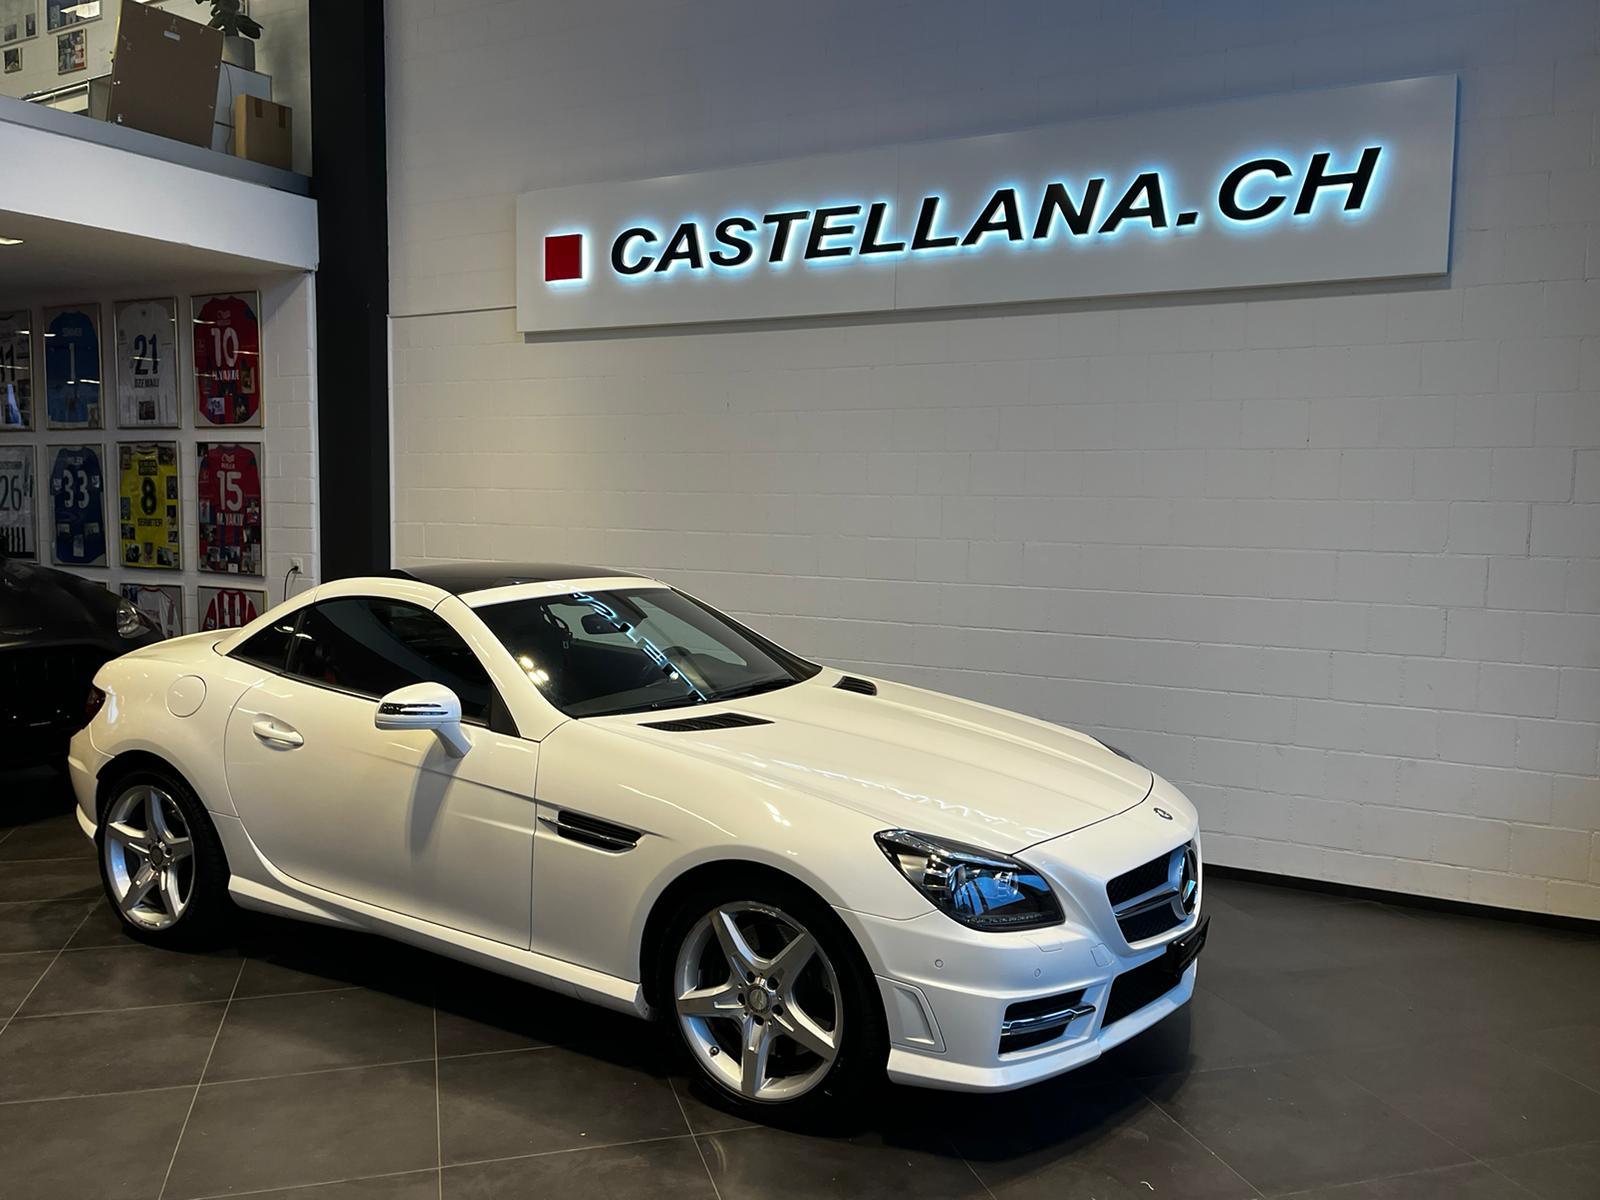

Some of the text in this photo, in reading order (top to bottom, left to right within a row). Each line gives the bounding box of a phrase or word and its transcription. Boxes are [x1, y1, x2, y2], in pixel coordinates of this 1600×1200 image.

[611, 145, 1382, 275] CASTELLANA.CH
[135, 334, 158, 374] 21
[210, 326, 239, 367] 10
[0, 475, 22, 511] 26
[63, 469, 90, 509] 33
[142, 477, 157, 515] 8
[216, 470, 243, 512] 15
